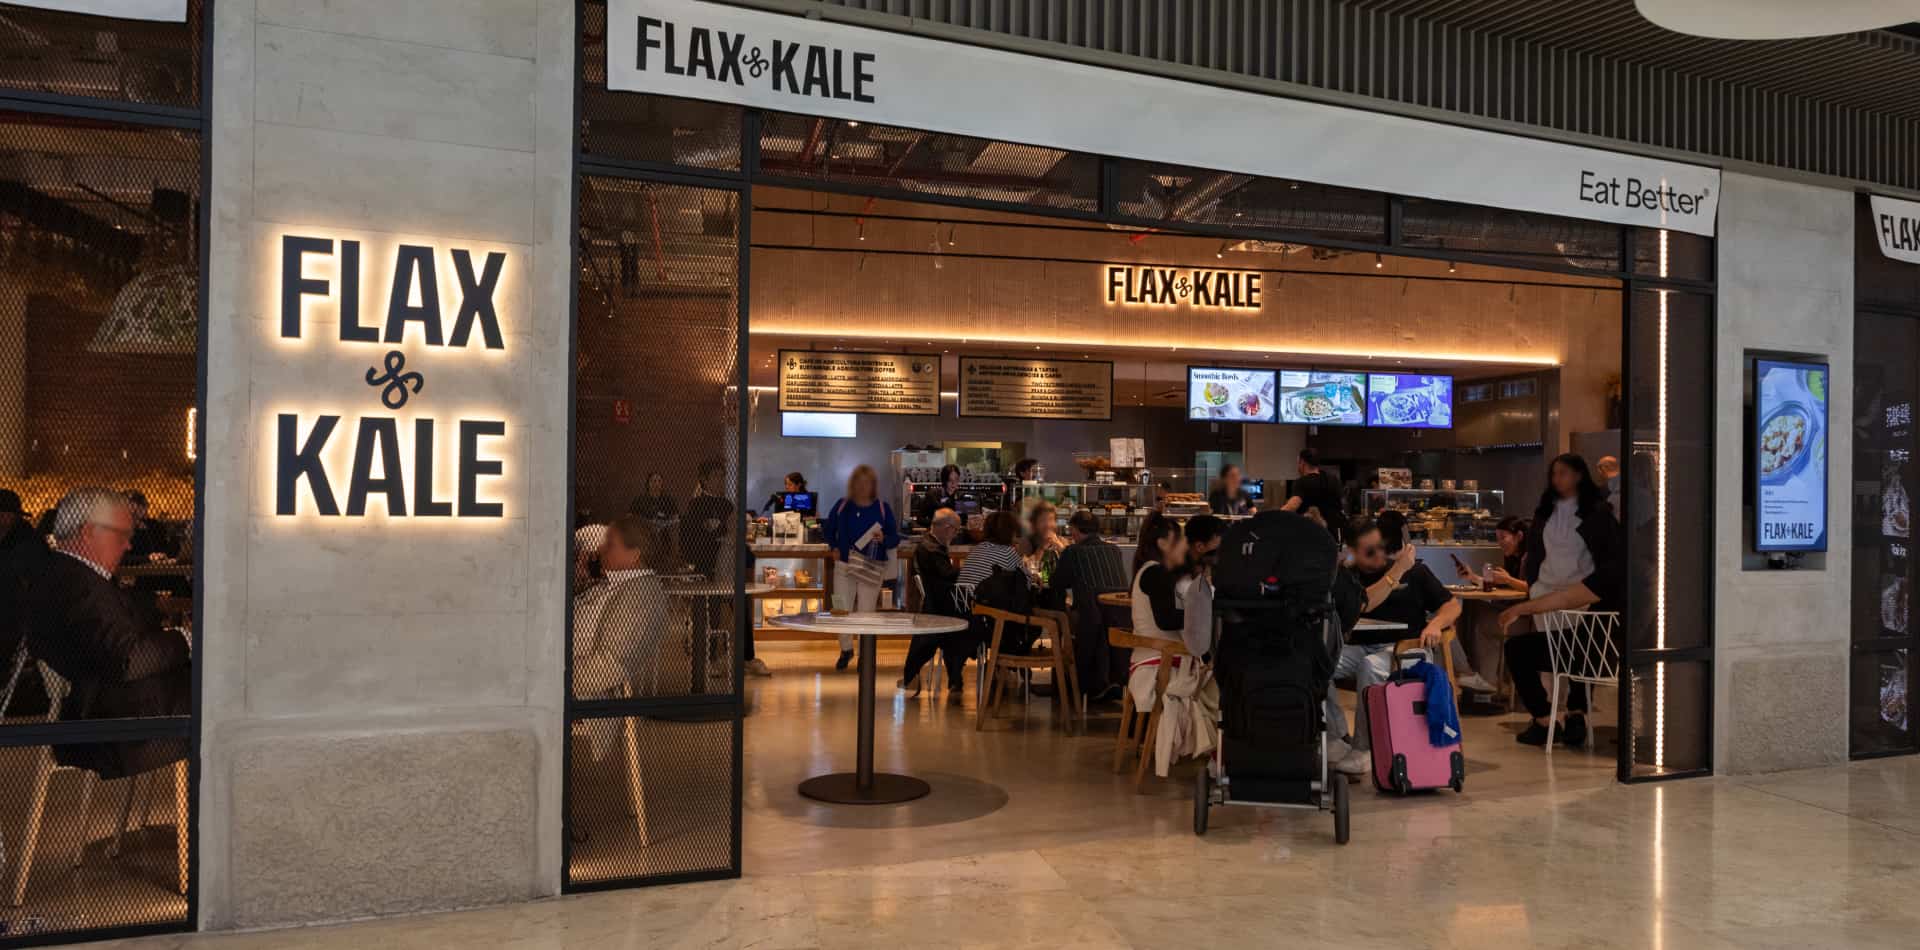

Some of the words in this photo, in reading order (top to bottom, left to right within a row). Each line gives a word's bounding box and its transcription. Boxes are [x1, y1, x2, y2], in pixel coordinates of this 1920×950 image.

[1579, 170, 1621, 206] Eat
[280, 235, 507, 349] FLAX
[365, 350, 424, 410] &
[276, 413, 505, 518] KALE
